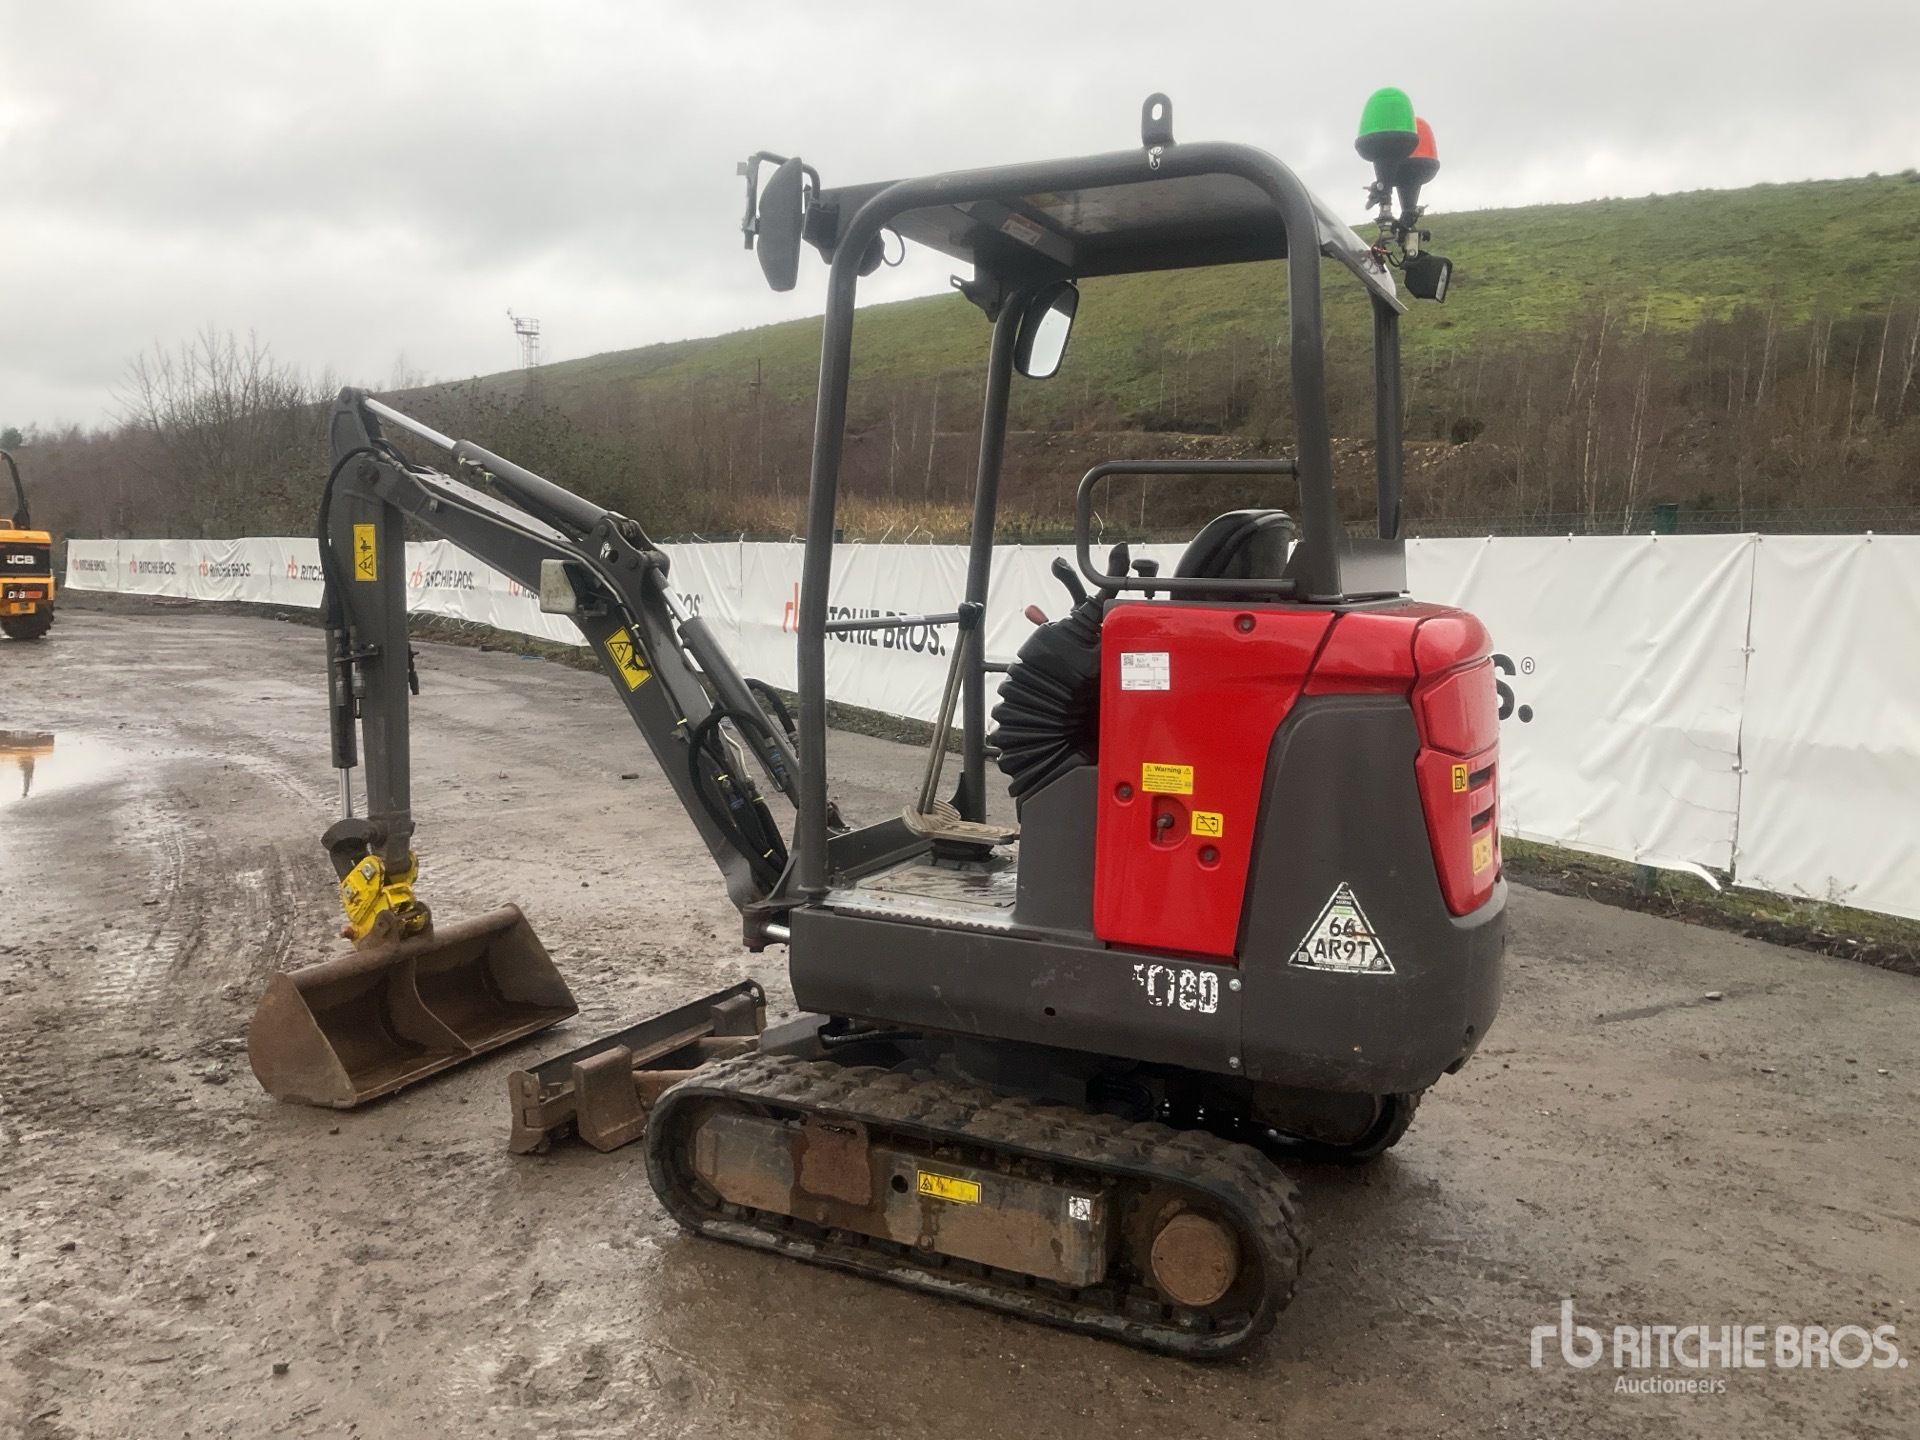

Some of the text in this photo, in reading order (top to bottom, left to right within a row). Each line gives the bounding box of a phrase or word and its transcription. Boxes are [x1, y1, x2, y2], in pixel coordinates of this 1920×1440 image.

[6, 554, 35, 565] JCB
[1153, 765, 1182, 775] Warning
[1314, 938, 1371, 965] AR9T
